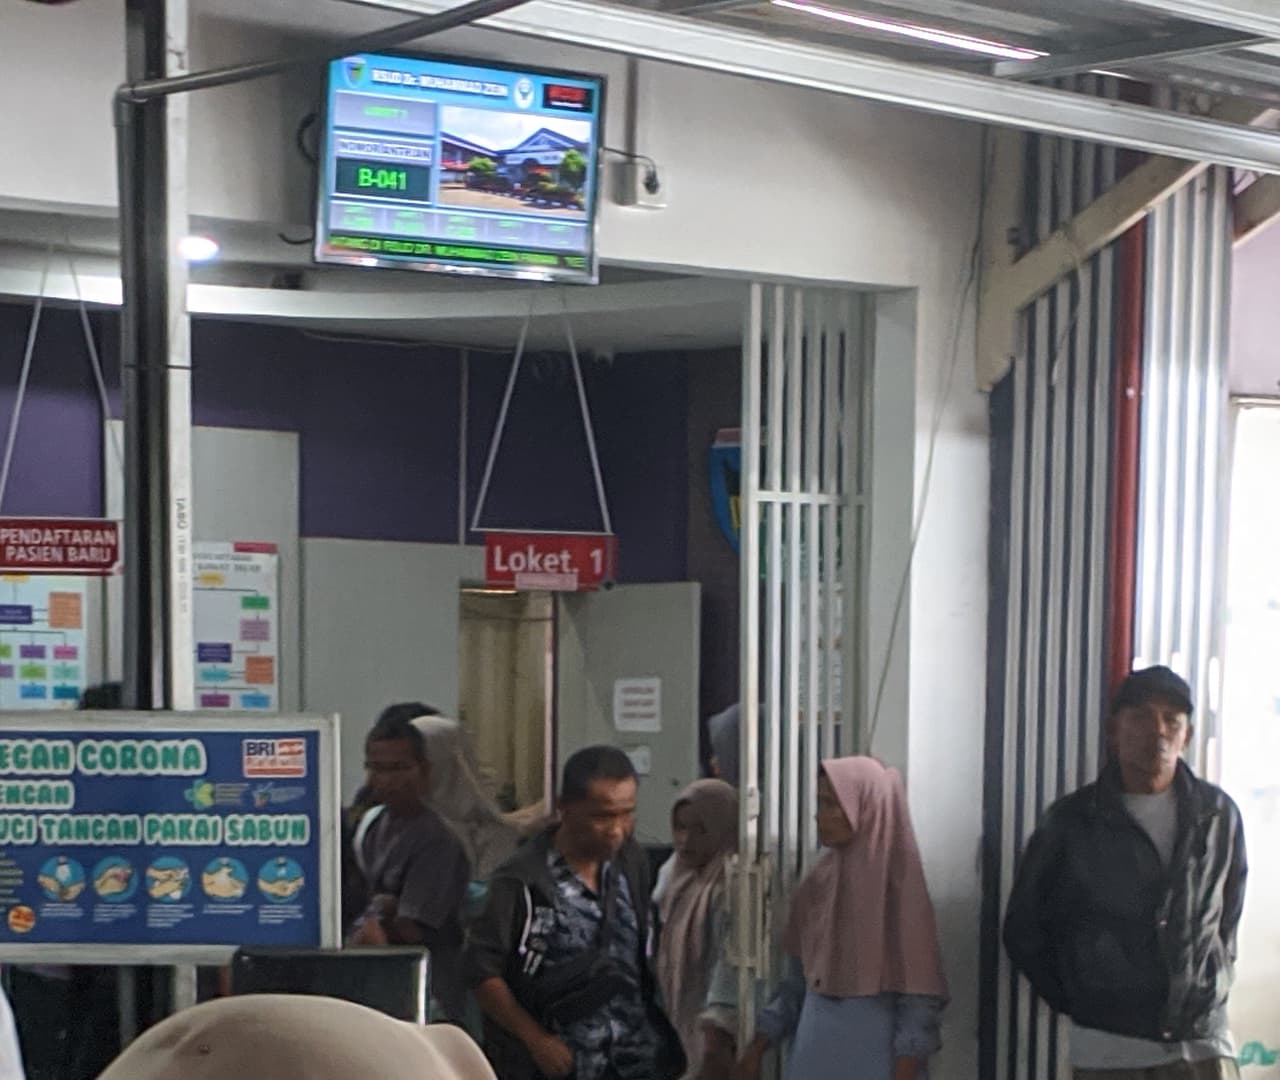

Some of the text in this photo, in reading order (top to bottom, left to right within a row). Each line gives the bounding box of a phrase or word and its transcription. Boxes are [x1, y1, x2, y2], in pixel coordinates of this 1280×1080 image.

[358, 167, 407, 190] B-041
[0, 527, 117, 546] PENDAFTARAN
[5, 545, 64, 562] PASIEN
[67, 546, 111, 562] BARU
[589, 549, 603, 575] 1
[78, 742, 203, 772] CORONA
[246, 742, 276, 756] BRI
[40, 816, 139, 843] TANGAN
[146, 817, 220, 843] PAKAI
[226, 818, 307, 844] SABUN
